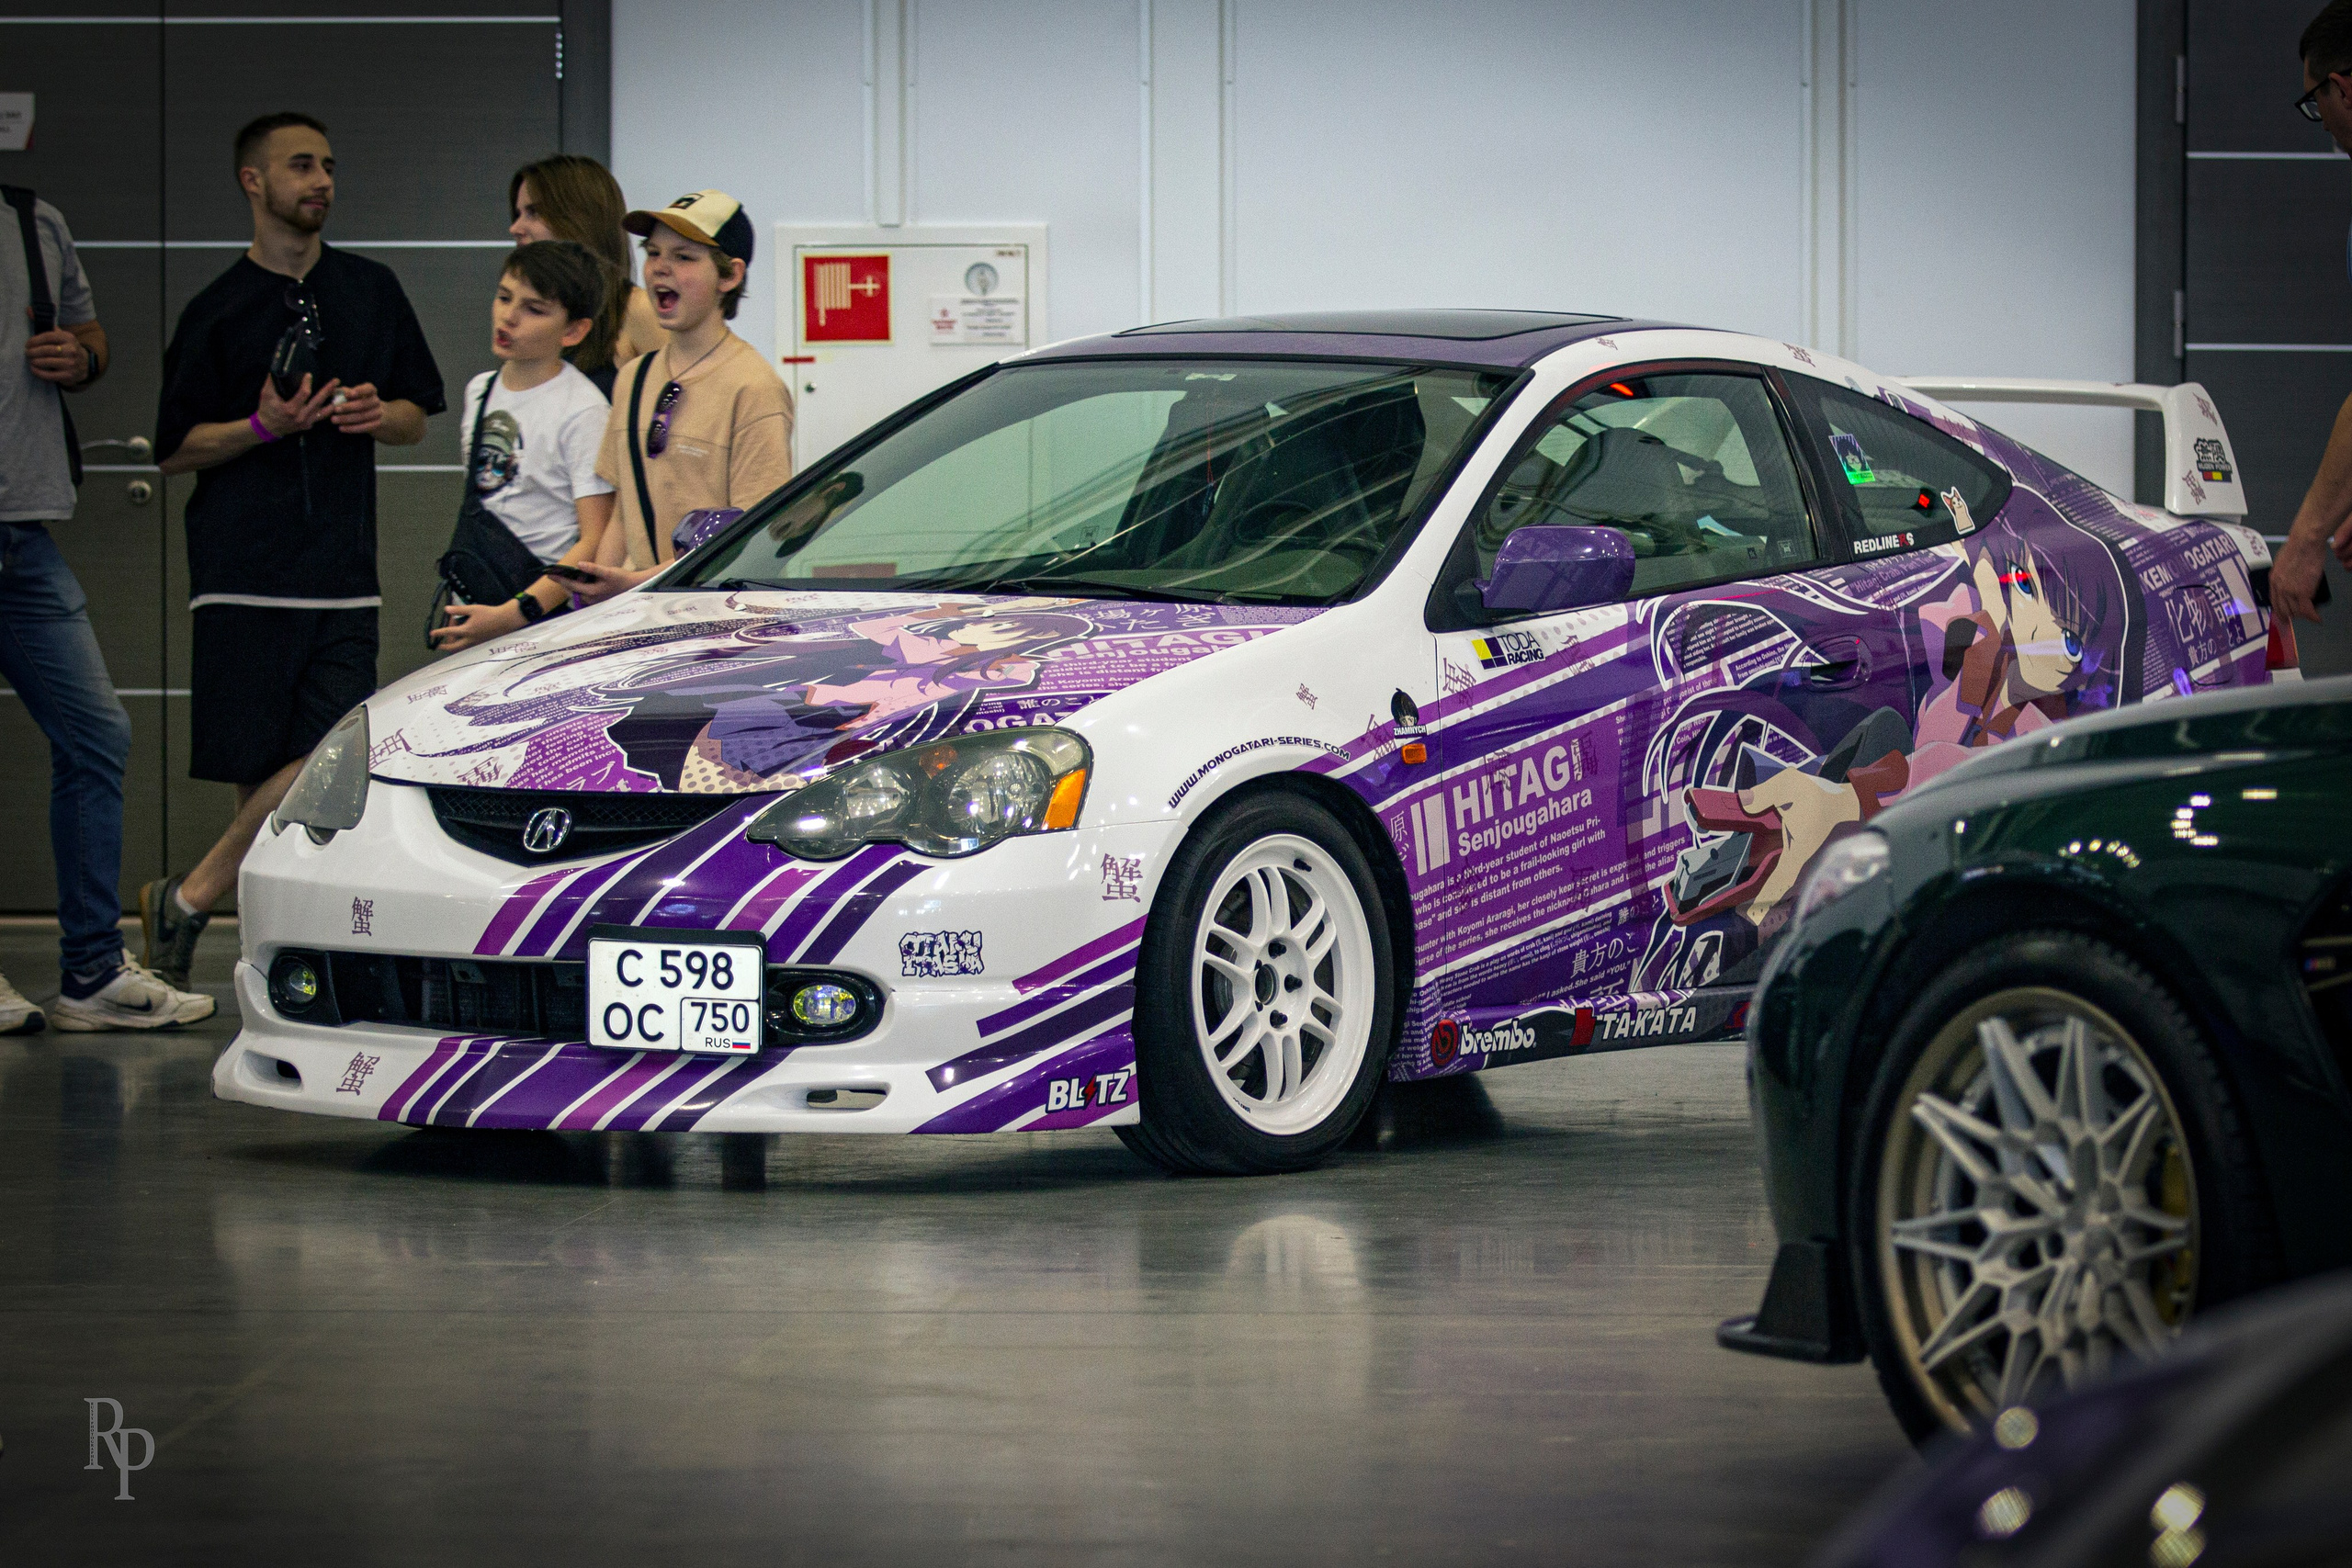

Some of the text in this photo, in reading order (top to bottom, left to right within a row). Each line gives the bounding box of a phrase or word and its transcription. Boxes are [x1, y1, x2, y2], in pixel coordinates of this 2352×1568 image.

[1854, 533, 1915, 554] REDLINERS
[1497, 631, 1540, 651] TODA
[1508, 649, 1544, 665] RACING
[1453, 738, 1584, 831] HITAGI
[1458, 788, 1592, 856] Senjougahara
[1505, 842, 1537, 863] student
[1540, 836, 1548, 849] of
[1550, 823, 1585, 844] Naoetsu
[1415, 903, 1431, 916] who
[1433, 896, 1441, 907] is
[1489, 874, 1498, 886] to
[1500, 868, 1511, 880] be
[1521, 845, 1570, 872] frail-looking
[1571, 837, 1586, 853] girl
[1588, 829, 1606, 844] with
[1440, 929, 1456, 942] with
[1457, 918, 1485, 939] Koyomi
[1487, 904, 1516, 926] Araragi,
[1518, 900, 1530, 912] her
[1531, 888, 1556, 906] closely
[1600, 867, 1608, 877] is
[1657, 835, 1686, 853] triggers
[1471, 896, 1479, 907] is
[1480, 885, 1510, 904] distant
[1511, 876, 1532, 891] from
[1533, 863, 1563, 882] others.
[1435, 950, 1443, 958] of
[1444, 943, 1457, 954] the
[1458, 932, 1483, 950] series,
[1485, 927, 1498, 938] she
[1499, 913, 1532, 932] receives
[1532, 907, 1544, 919] the
[1611, 874, 1624, 887] and
[1657, 854, 1675, 868] alias
[660, 950, 734, 990] 598
[1589, 971, 1605, 983] said
[690, 1002, 750, 1033] 750
[1459, 1017, 1536, 1055] brembo
[1600, 1007, 1697, 1040] TAKATA
[705, 1037, 730, 1048] RUS
[1046, 1071, 1130, 1112] BLITZ
